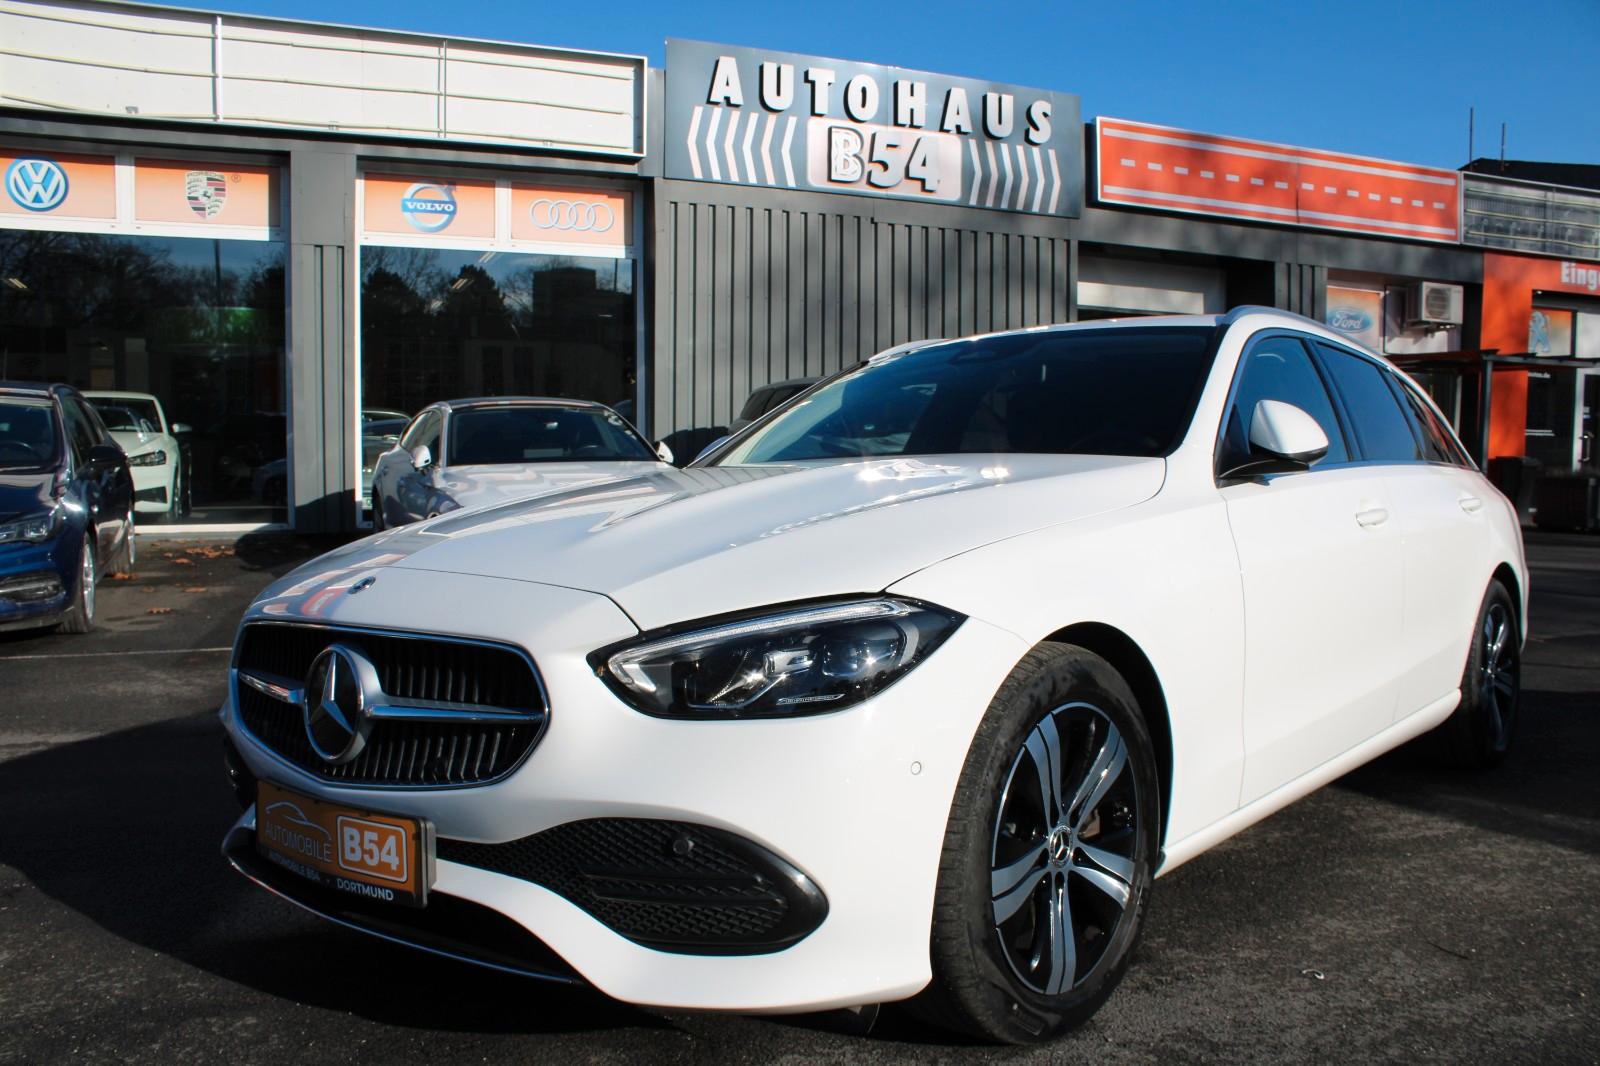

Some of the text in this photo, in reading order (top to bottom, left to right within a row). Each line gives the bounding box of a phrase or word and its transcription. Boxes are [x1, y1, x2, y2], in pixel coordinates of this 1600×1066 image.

[706, 55, 1052, 146] AUTOHAUS
[829, 126, 943, 193] B54
[407, 201, 455, 212] VOLVO
[1560, 261, 1600, 291] Eing
[1332, 310, 1363, 328] Ford
[266, 822, 332, 862] AUTOMOBILE
[343, 825, 400, 872] B54
[336, 878, 395, 901] DORTMUND
